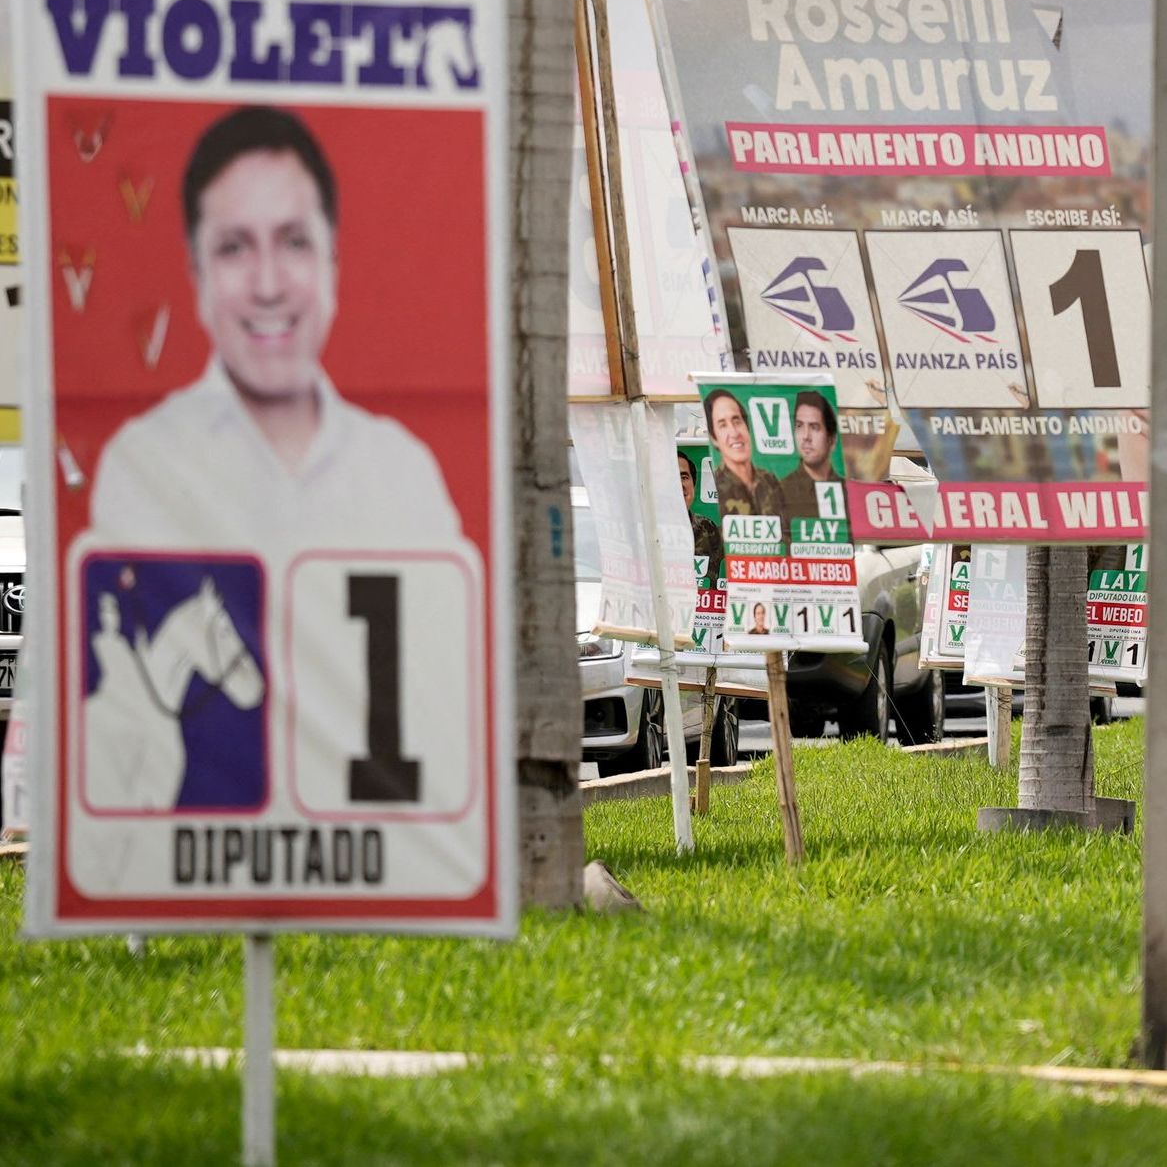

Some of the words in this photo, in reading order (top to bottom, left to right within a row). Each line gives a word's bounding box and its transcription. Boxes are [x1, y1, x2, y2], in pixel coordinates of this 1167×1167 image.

[775, 44, 1059, 112] Amuruz
[730, 129, 967, 167] PARLAMENTO
[973, 131, 1106, 168] ANDINO
[741, 206, 800, 225] MARCA
[802, 204, 835, 226] ASÍ:
[881, 208, 941, 227] MARCA
[945, 206, 979, 227] ASÍ:
[1025, 209, 1088, 227] ESCRIBE
[1090, 204, 1123, 227] ASÍ:
[1049, 249, 1123, 388] 1
[757, 350, 831, 369] AVANZA
[836, 347, 877, 370] PAÍS
[895, 351, 970, 370] AVANZA
[975, 348, 1019, 370] PAÍS
[755, 401, 781, 437] V
[930, 416, 1063, 436] PARLAMENTO
[1068, 415, 1143, 435] ANDINO
[762, 439, 788, 449] VERDE
[823, 485, 837, 515] 1
[728, 518, 778, 539] ALEX
[800, 520, 840, 542] LAY
[793, 544, 833, 555] DIPUTADO
[833, 545, 851, 556] LIMA
[1132, 544, 1144, 570] 1
[730, 560, 747, 579] SE
[748, 558, 789, 580] ACABÓ
[791, 564, 807, 581] EL
[808, 563, 851, 582] WEBEO
[1100, 572, 1140, 591] LAY
[1089, 592, 1128, 602] DIPUTADO
[730, 602, 746, 625] V
[773, 603, 790, 627] V
[797, 606, 809, 633] 1
[817, 605, 834, 628] V
[842, 606, 856, 633] 1
[1102, 606, 1143, 623] WEBEO
[950, 624, 965, 642] V
[1104, 640, 1120, 660] V
[1126, 643, 1139, 666] 1
[346, 571, 423, 804] 1
[172, 826, 385, 886] DIPUTADO
